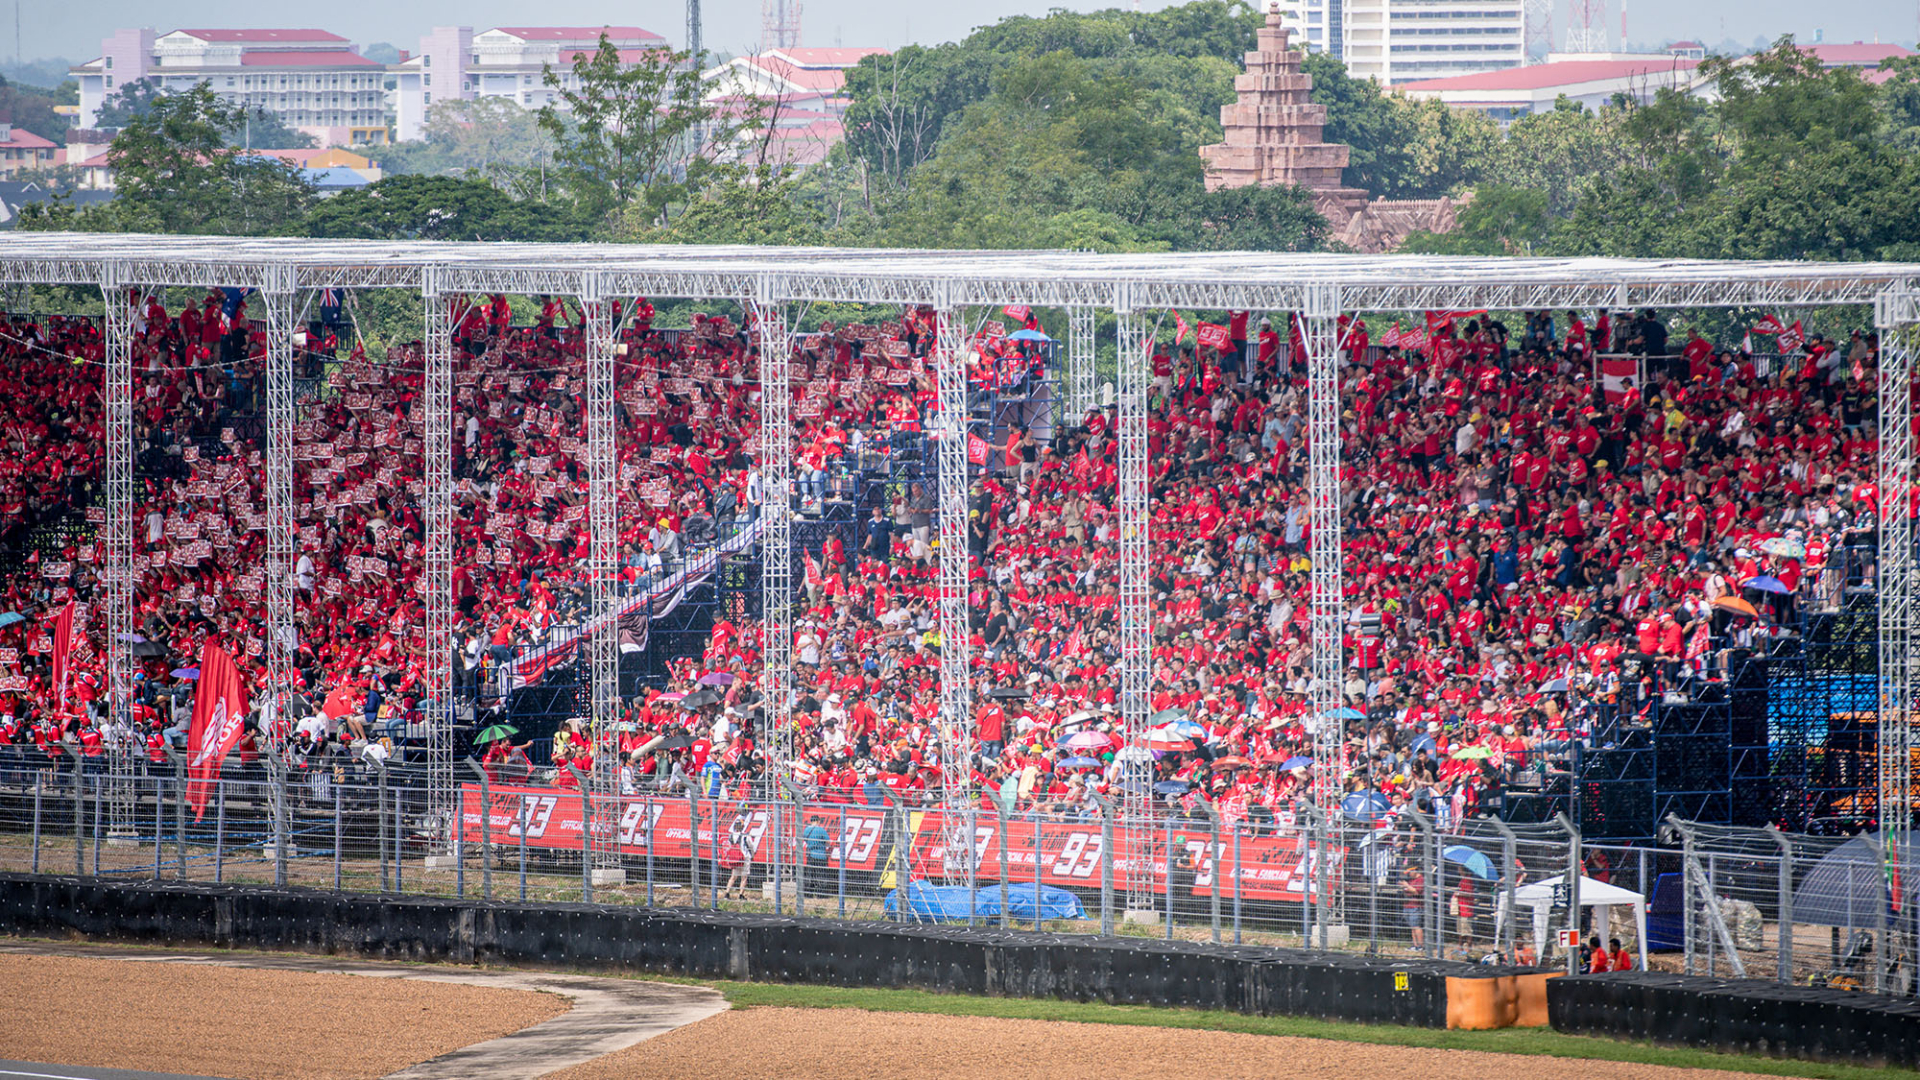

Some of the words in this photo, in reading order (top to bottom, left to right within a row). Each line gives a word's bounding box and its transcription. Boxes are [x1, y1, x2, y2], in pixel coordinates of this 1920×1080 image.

[1535, 623, 1550, 633] 93
[508, 796, 557, 839] 93
[620, 802, 664, 847] 93
[831, 817, 883, 863] 93
[995, 852, 1024, 862] OICIAL
[1024, 853, 1056, 865] FANLUB
[1052, 832, 1103, 879] 93
[1560, 932, 1568, 946] F
